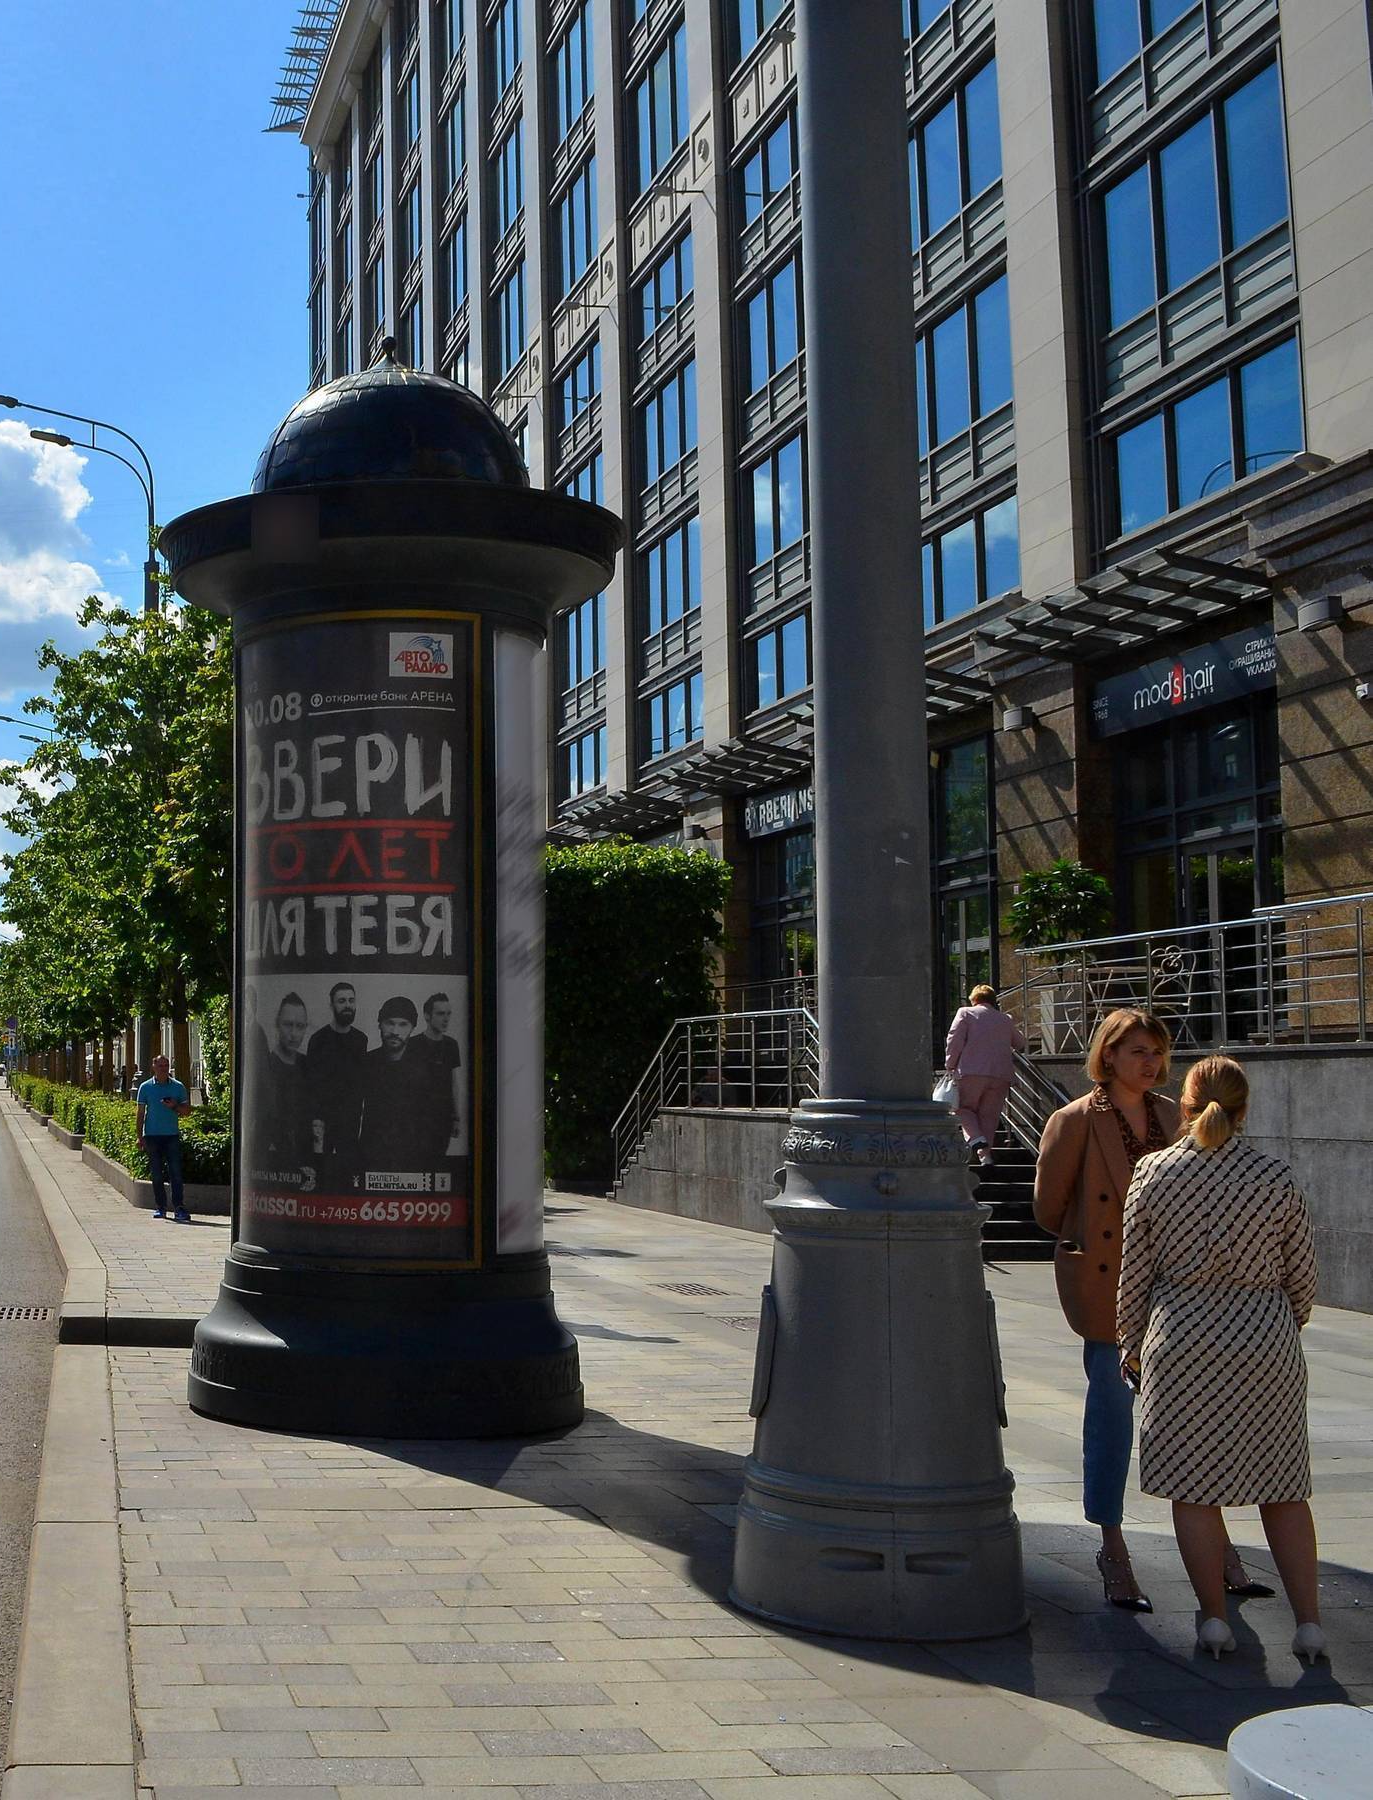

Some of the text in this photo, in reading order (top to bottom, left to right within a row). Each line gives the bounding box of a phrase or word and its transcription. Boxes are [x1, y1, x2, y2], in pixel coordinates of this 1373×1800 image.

[394, 650, 430, 662] АВТО
[404, 662, 448, 674] РАДИО
[1182, 661, 1216, 694] hair
[325, 689, 454, 704] открытие банк АРЕНА
[246, 733, 452, 826] ЗВЕРИ
[247, 829, 452, 881] 0 ЛЕТ
[245, 895, 453, 959] ДЛЯ ТЕБЯ
[368, 1174, 401, 1183] БИЛЕТЫ
[368, 1182, 418, 1190] MELNITSA.RU
[319, 1205, 358, 1221] +7495
[359, 1201, 451, 1222] 6659999
